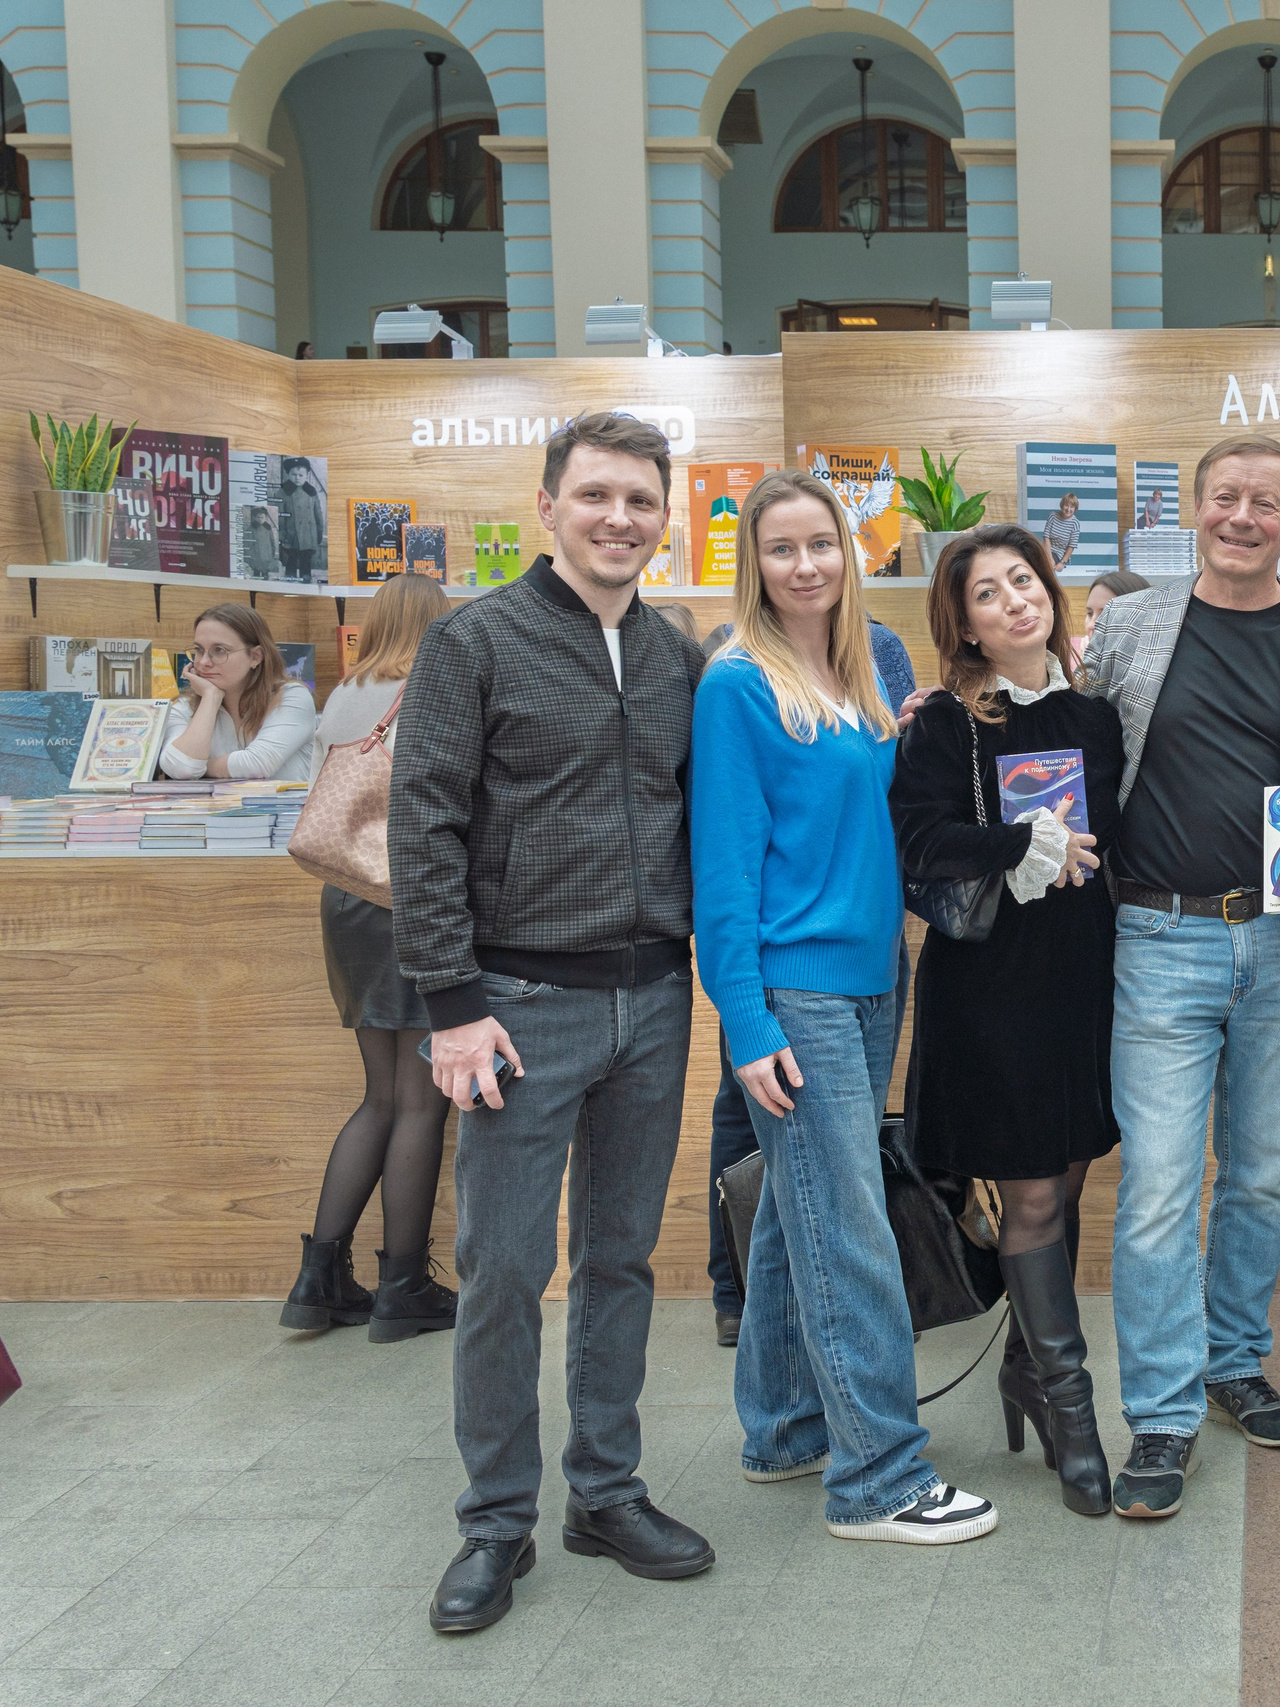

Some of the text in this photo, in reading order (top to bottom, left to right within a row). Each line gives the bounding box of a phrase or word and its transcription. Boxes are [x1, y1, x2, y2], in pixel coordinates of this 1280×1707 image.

[829, 454, 877, 470] Пиши,
[132, 450, 222, 496] ВИНО
[254, 454, 267, 503] ПРАВИЛА
[812, 469, 890, 483] сокращай
[153, 495, 220, 531] ОГИЯ
[366, 547, 397, 559] HOMO
[413, 560, 436, 568] HOMO
[719, 562, 737, 571] НАМ
[51, 640, 90, 650] ЭПОХА
[104, 641, 137, 653] ГОРОД
[53, 648, 96, 657] ПЕРЕМЕН
[14, 738, 77, 746] ТАЙМ ЛАПС
[1034, 757, 1077, 767] Путешествие
[1031, 764, 1070, 774] подлинному
